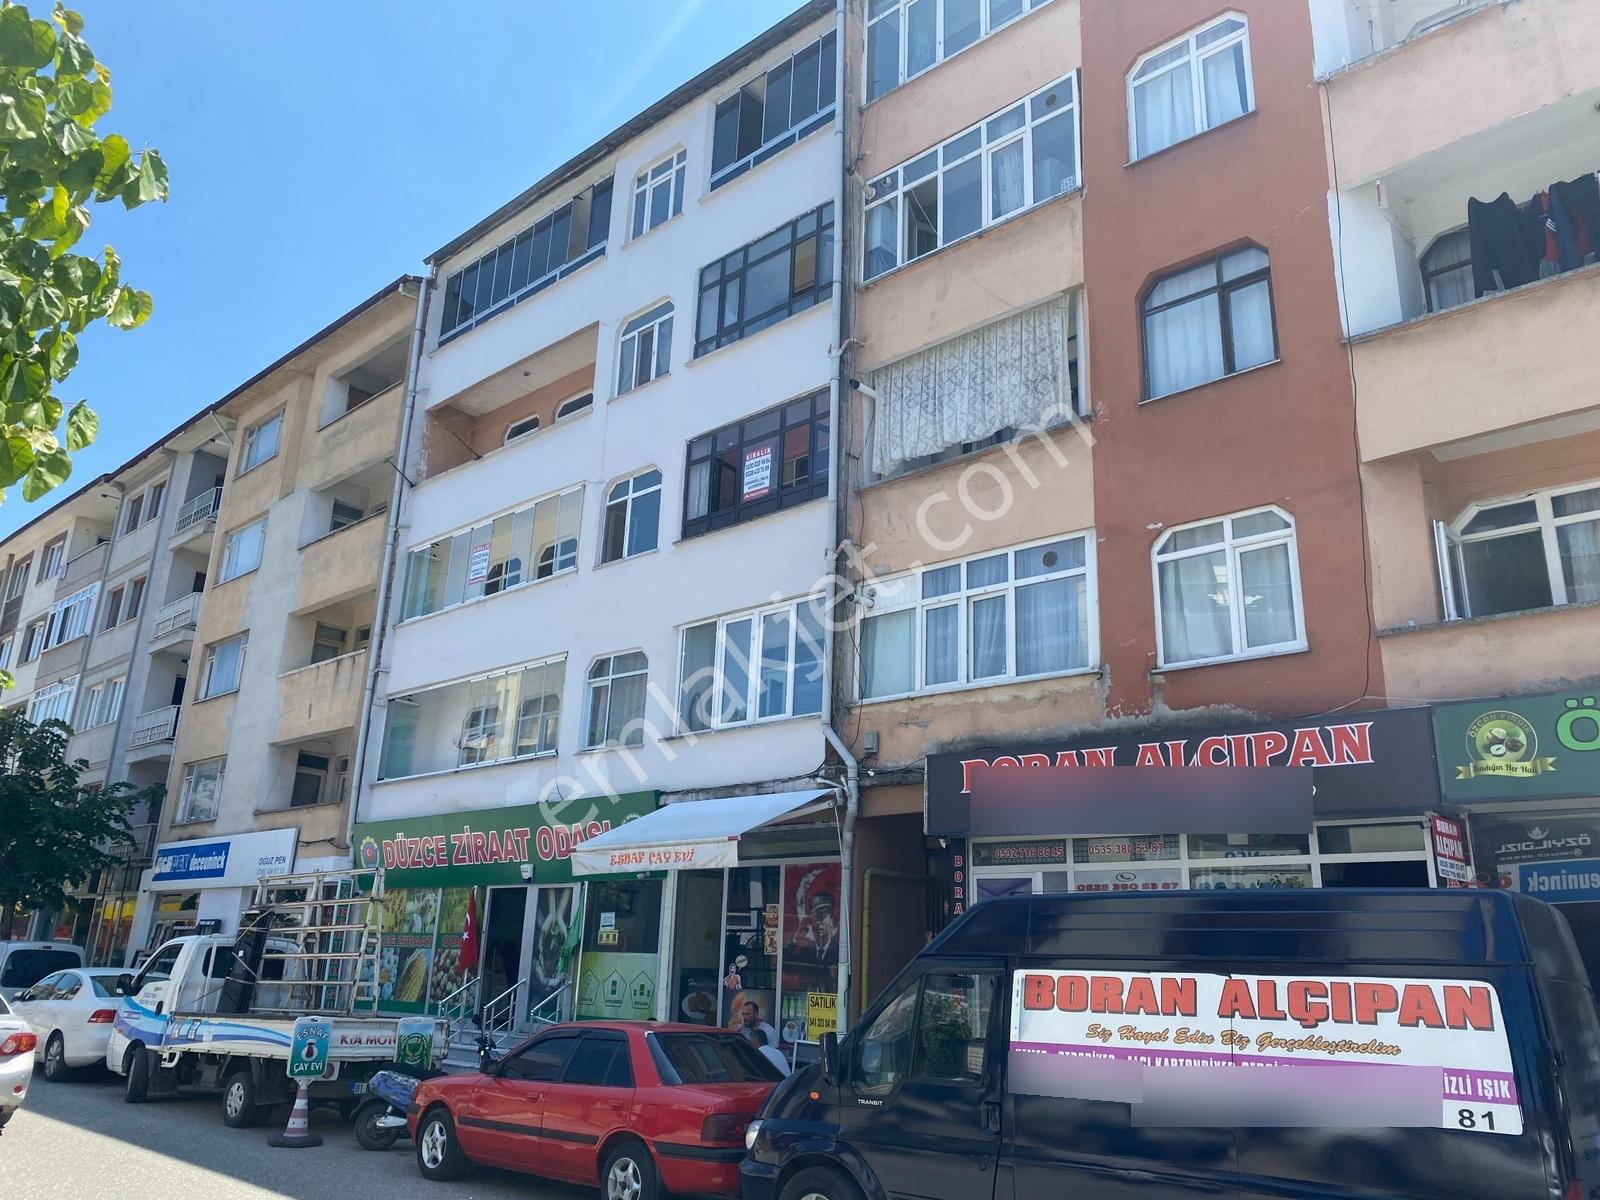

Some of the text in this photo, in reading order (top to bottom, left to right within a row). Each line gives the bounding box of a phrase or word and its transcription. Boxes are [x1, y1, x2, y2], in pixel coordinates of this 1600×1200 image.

[1469, 712, 1532, 738] ÖZCAN FINDIK
[1504, 763, 1519, 772] Her
[382, 819, 612, 870] DÜZCE ZİRAAT ODASI
[1088, 841, 1164, 855] 0535 380 53 87
[258, 855, 287, 866] OĞUZ PEN
[609, 852, 645, 866] ESNAF
[673, 848, 696, 863] EVİ
[953, 855, 964, 915] BORA
[810, 995, 837, 1009] SATILIK
[1024, 974, 1495, 1031] BORAN ALÇIPAN
[296, 1027, 329, 1041] ESNAF
[340, 1035, 362, 1045] KIA
[1086, 1023, 1401, 1055] Siz Hayal Edin Biz Gerçekleştirelim
[293, 1059, 323, 1073] ÇAY EVİ
[1443, 1072, 1511, 1100] İZLİ IŞIK
[857, 1098, 884, 1106] TRANSIT
[1458, 1108, 1495, 1131] 81
